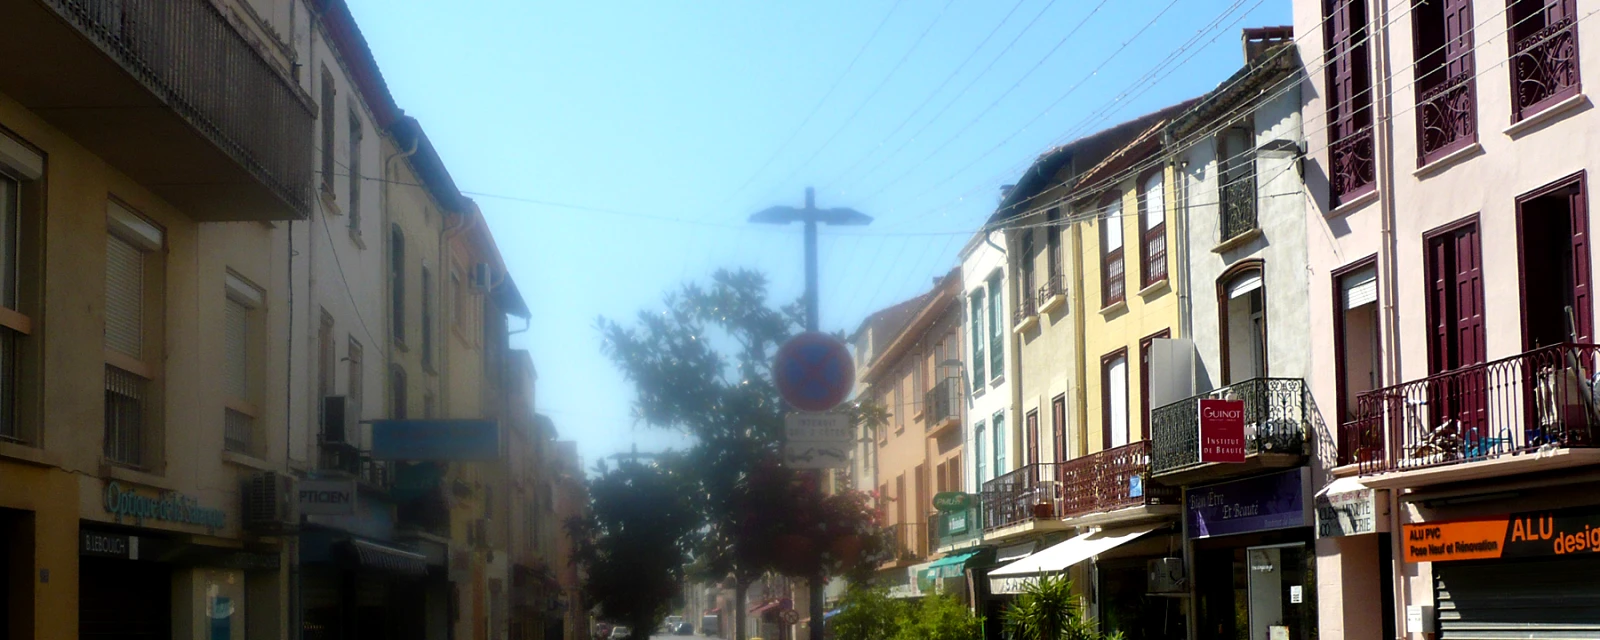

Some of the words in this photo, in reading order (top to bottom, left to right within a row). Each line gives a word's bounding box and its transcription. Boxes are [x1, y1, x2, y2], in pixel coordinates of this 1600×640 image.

[1203, 406, 1241, 418] GUINOT
[1207, 437, 1239, 445] INSTITUT
[106, 480, 158, 527] Optique
[299, 490, 350, 503] PTICIEN
[1233, 499, 1259, 518] Beauté
[1410, 528, 1424, 541] ALU
[1426, 527, 1441, 540] PVC
[1512, 513, 1553, 542] ALU
[1410, 544, 1427, 557] Pose
[1429, 544, 1445, 556] Neuf
[1446, 543, 1454, 554] et
[1455, 539, 1498, 553] Rénovation
[1554, 524, 1600, 555] desig
